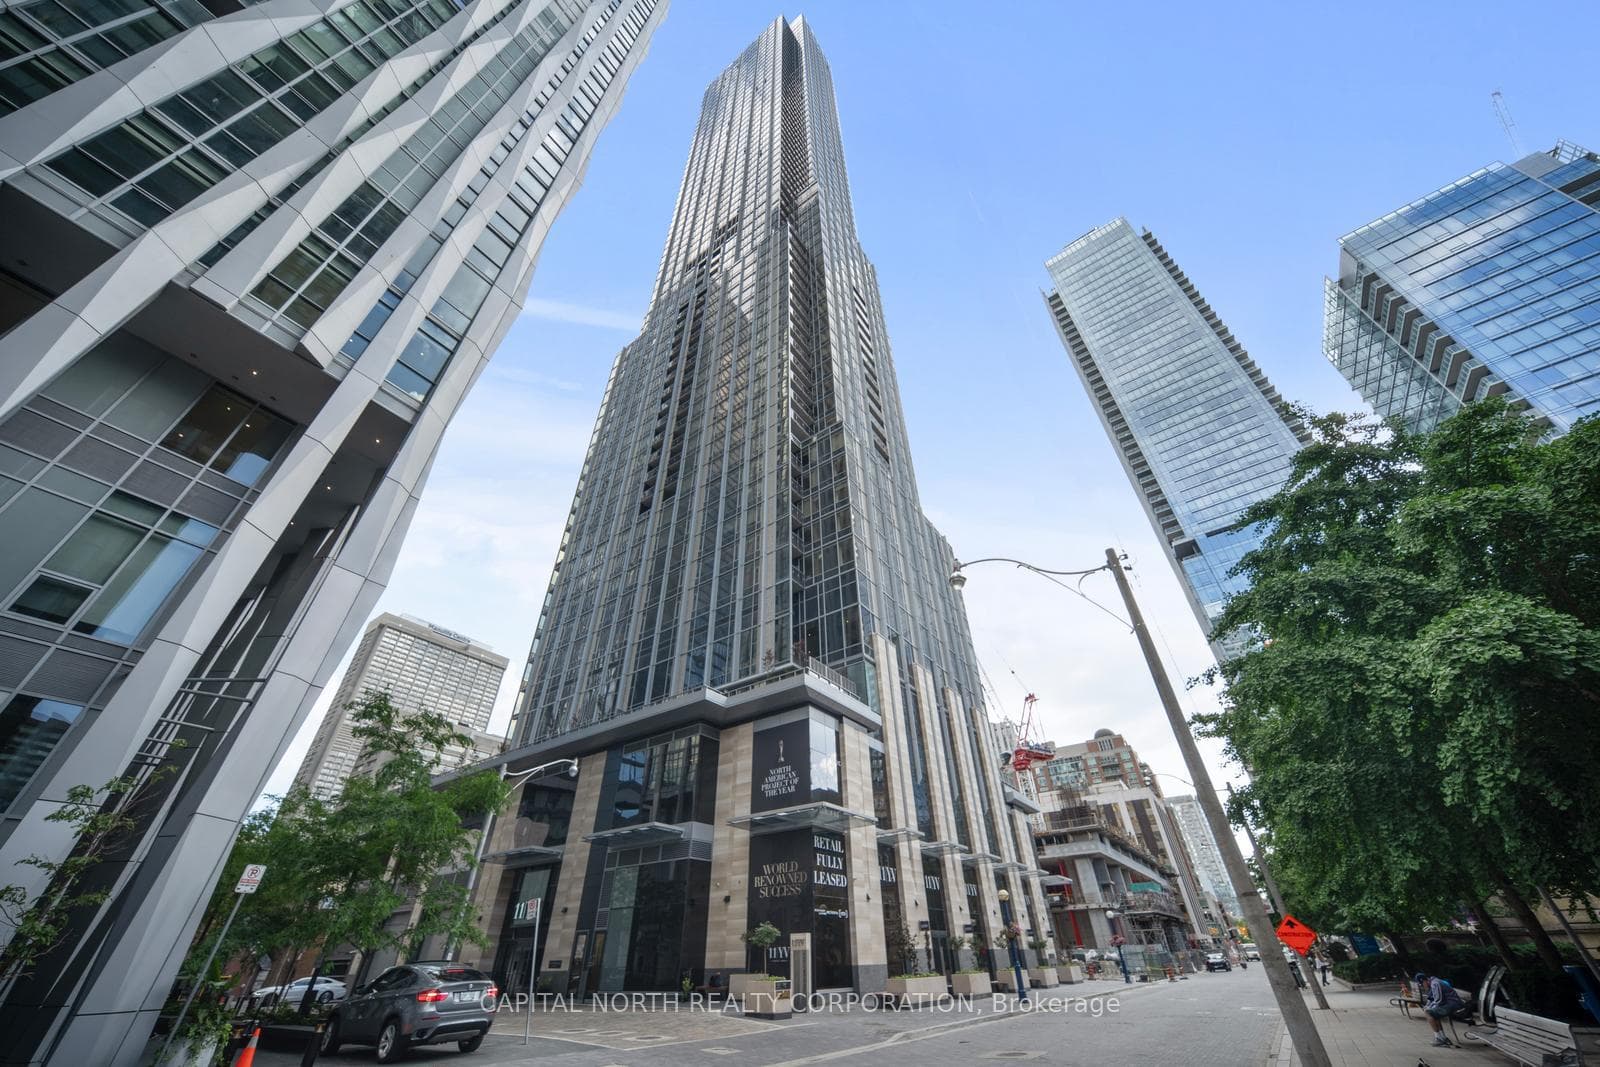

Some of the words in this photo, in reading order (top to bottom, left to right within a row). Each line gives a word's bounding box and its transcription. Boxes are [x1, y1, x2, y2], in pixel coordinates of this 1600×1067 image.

[763, 771, 797, 783] AMERICAN
[769, 765, 791, 775] NORTH
[761, 780, 788, 791] PROJECT
[789, 777, 800, 786] OF
[764, 788, 779, 798] THE
[779, 785, 796, 795] YEAR
[814, 835, 845, 854] RETAIL
[762, 861, 799, 876] WORLD
[816, 853, 844, 870] FULLY
[754, 871, 808, 888] RENOWNED
[813, 870, 848, 888] LEASED
[759, 883, 802, 899] SUCCESS
